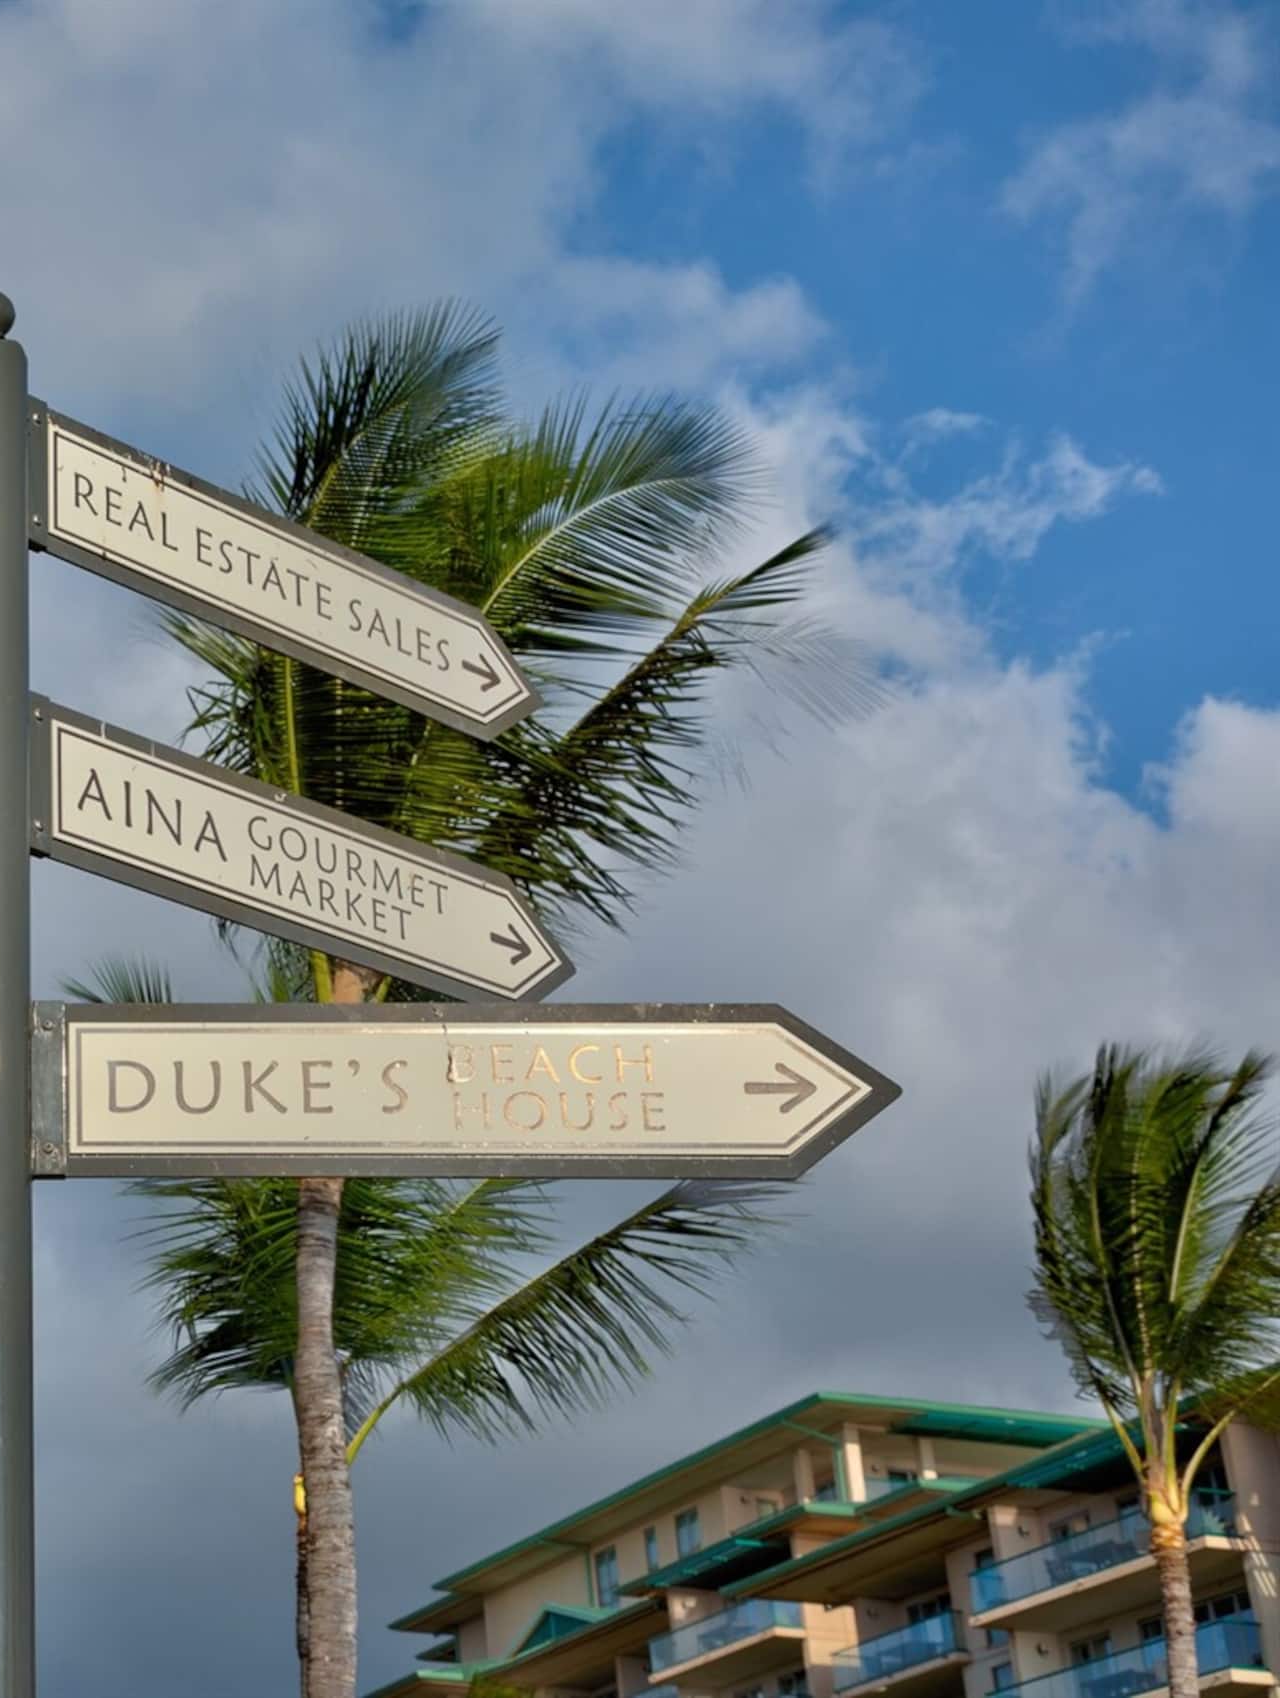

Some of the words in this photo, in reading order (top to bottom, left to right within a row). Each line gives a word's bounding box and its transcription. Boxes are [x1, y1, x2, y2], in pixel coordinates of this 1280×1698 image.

[73, 472, 178, 552] REAL
[196, 527, 333, 621] ESTATE
[348, 600, 451, 671] SALES
[77, 768, 227, 863] AINA
[247, 816, 448, 914] GOURMET
[250, 854, 412, 940] MARKET
[107, 1060, 408, 1113] DUKE'S
[448, 1043, 655, 1085] BEACH
[453, 1091, 666, 1132] HOUSE
